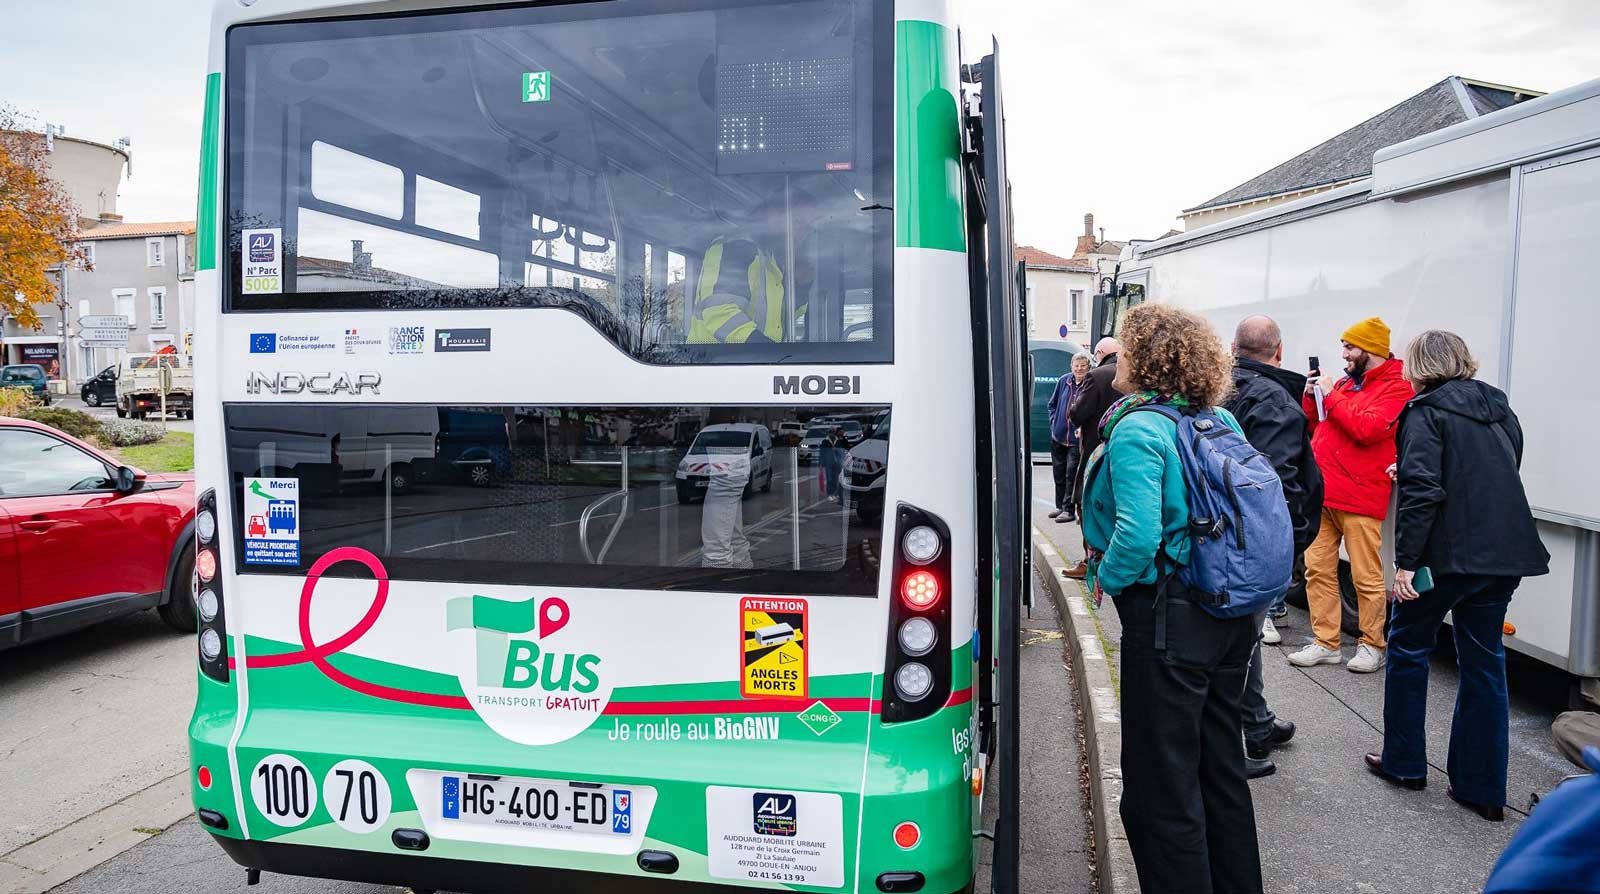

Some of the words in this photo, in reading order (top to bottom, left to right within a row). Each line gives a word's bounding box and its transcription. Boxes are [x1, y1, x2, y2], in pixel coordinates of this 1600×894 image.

[247, 266, 257, 275] N°
[258, 266, 277, 275] Parc
[244, 277, 279, 291] 5002
[388, 326, 425, 335] FRANCE
[388, 334, 425, 342] NATION
[300, 343, 336, 351] européenne
[389, 342, 417, 350] VERTE
[246, 370, 382, 395] INDCAR
[773, 375, 860, 395] MOBI
[270, 481, 296, 489] Merci
[254, 549, 274, 558] quittant
[285, 550, 298, 558] arrêt
[744, 599, 804, 611] ATTENTION
[502, 639, 602, 694] Bus
[750, 668, 798, 680] ANGLES
[753, 679, 796, 691] MORTS
[477, 695, 542, 708] TRANSPORT
[545, 696, 601, 713] GRATUIT
[810, 713, 828, 723] CNG
[608, 718, 630, 741] Je
[636, 719, 684, 742] roule
[687, 721, 709, 741] au
[714, 717, 780, 741] BioGNV
[951, 727, 969, 755] les
[258, 763, 310, 819] 100
[335, 769, 378, 825] 70
[448, 801, 454, 810] F
[463, 781, 607, 825] HG-400-ED
[757, 796, 792, 815] AV
[614, 813, 630, 829] 79
[723, 834, 762, 844] AUDOUARD
[763, 837, 795, 847] MOBILITE
[796, 840, 827, 848] URBAINE
[791, 848, 821, 856] Germain
[737, 859, 758, 867] 49700
[759, 861, 790, 870] DOUE-EN
[748, 870, 758, 878] 02
[772, 872, 782, 880] 56
[784, 873, 793, 881] 13
[795, 874, 805, 882] 93
